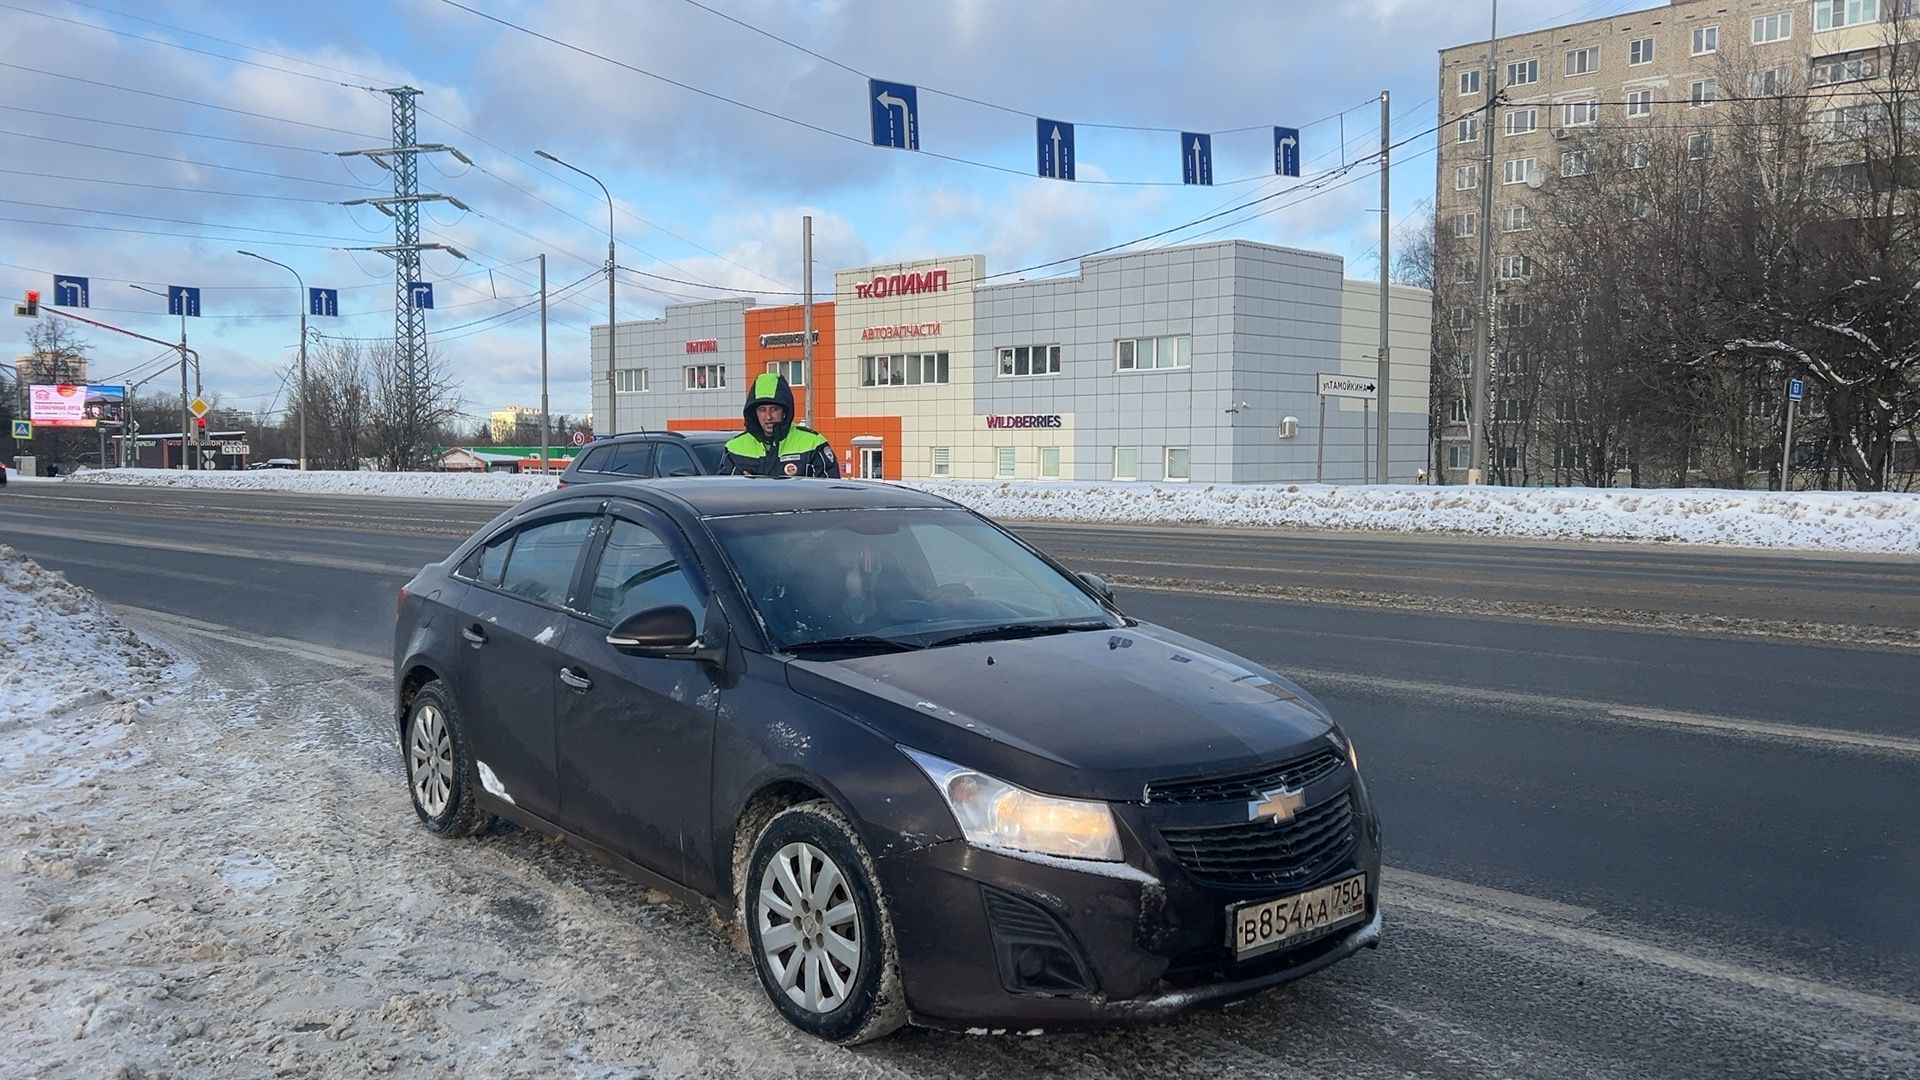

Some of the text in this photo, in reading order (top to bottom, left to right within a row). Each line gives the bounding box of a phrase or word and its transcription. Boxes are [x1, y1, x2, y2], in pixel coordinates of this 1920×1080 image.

[855, 269, 948, 299] ТК ОЛИМП
[861, 321, 942, 341] АВТОЗАПЧАСТИ
[986, 415, 1062, 429] WILDBERRIES
[224, 446, 248, 454] СТОП
[1338, 904, 1353, 916] RUS
